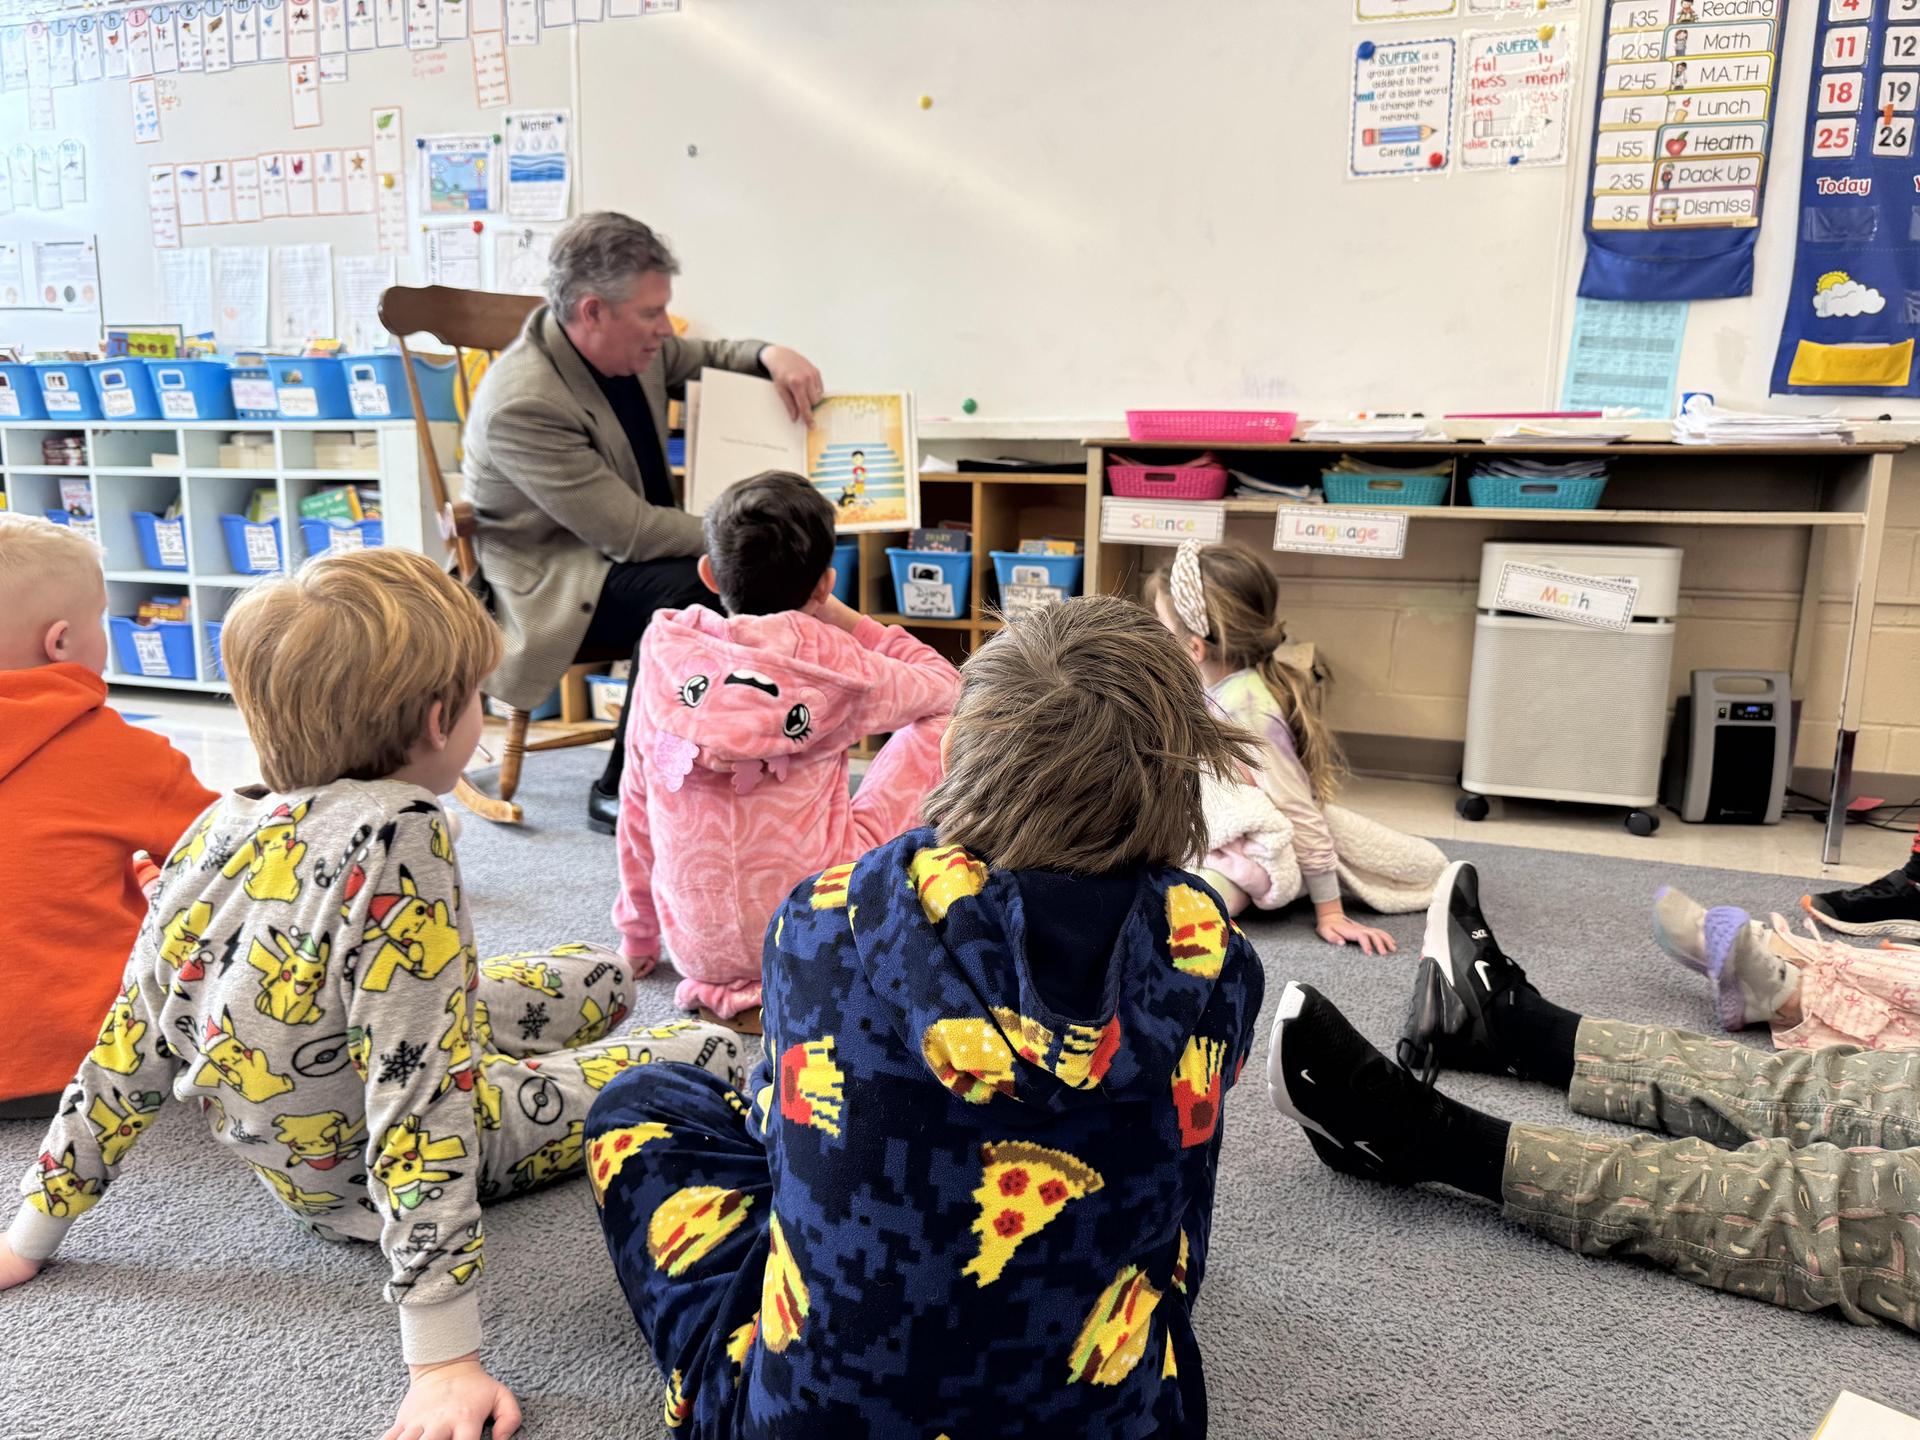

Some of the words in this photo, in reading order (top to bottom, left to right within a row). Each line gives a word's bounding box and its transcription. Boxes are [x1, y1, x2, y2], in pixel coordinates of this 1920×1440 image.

[185, 5, 193, 17] k
[1702, 0, 1774, 17] Reading
[81, 18, 89, 32] g
[109, 14, 116, 28] h
[1486, 45, 1494, 54] A
[1496, 39, 1539, 54] SUFFIX
[1703, 32, 1751, 50] Math
[1835, 36, 1856, 58] 11
[1892, 36, 1917, 57] 12
[1378, 50, 1420, 66] SUFFIX
[1366, 68, 1395, 79] group
[1409, 64, 1440, 73] letters
[1371, 78, 1404, 88] added
[1417, 75, 1433, 84] the
[1618, 73, 1656, 91] 12:45
[1398, 88, 1422, 98] base
[1424, 85, 1448, 95] word
[1827, 82, 1853, 104] 18
[1888, 82, 1911, 102] 19
[1380, 100, 1415, 112] change
[1417, 98, 1433, 108] the
[1697, 98, 1751, 116] Lunch
[519, 118, 553, 133] Water
[1694, 134, 1754, 151] Health
[1817, 128, 1850, 149] 25
[1878, 127, 1907, 147] 26
[1379, 144, 1421, 157] Careful
[1727, 165, 1751, 183] Up
[1817, 177, 1871, 196] Today
[1683, 197, 1751, 215] Dismiss
[112, 337, 171, 356] Trees
[1131, 514, 1196, 532] Science
[1295, 519, 1378, 544] Language
[924, 531, 952, 543] DIARY
[914, 585, 946, 603] Diary
[1539, 584, 1590, 611] Math
